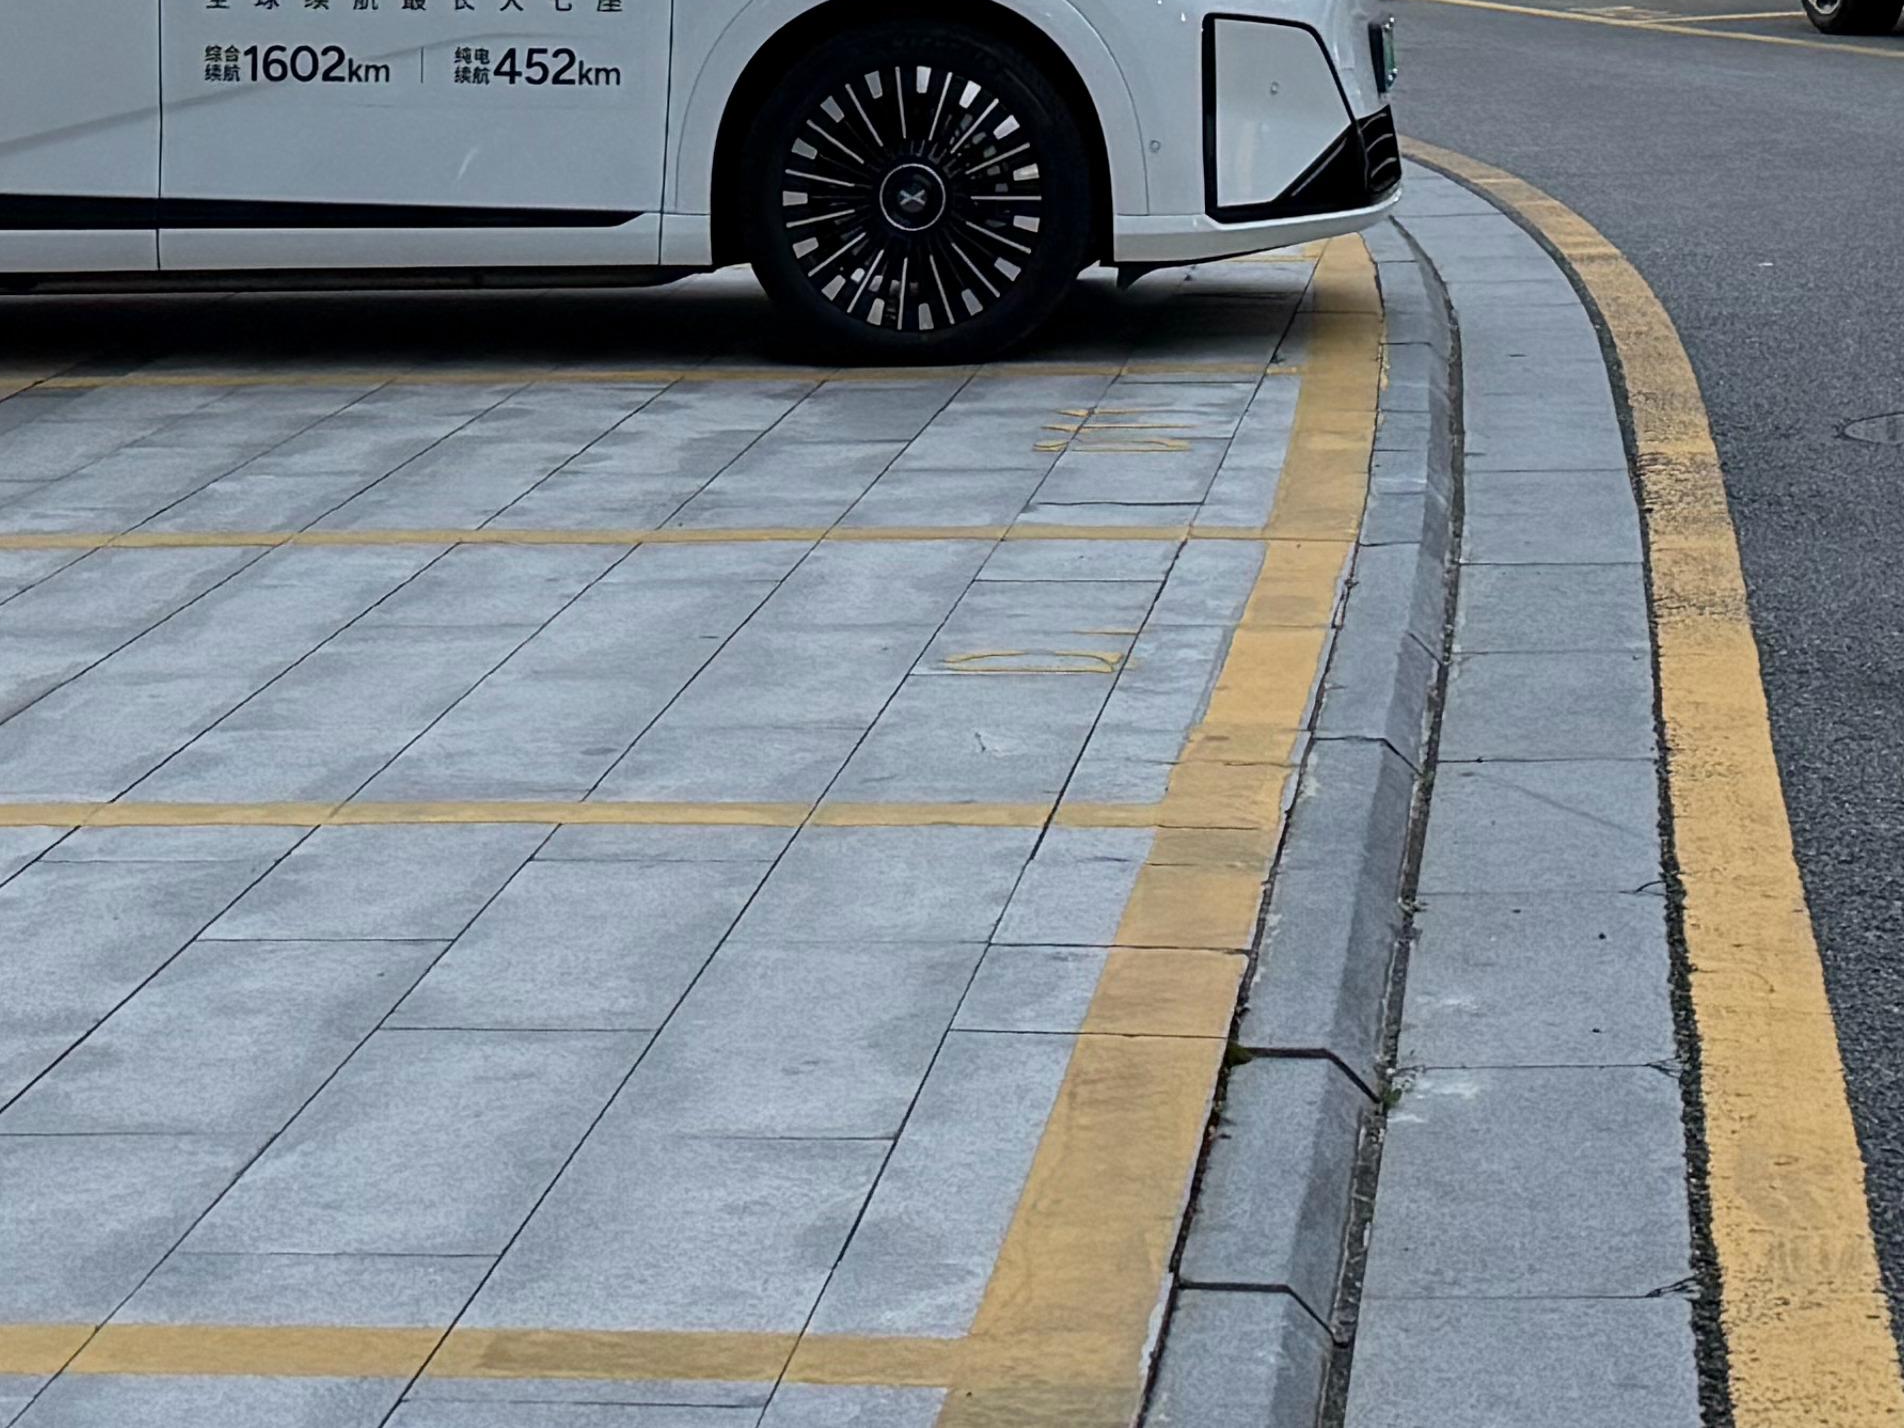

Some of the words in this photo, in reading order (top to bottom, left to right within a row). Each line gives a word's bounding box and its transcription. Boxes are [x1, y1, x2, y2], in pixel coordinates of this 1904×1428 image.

[204, 45, 240, 63] 综合
[454, 46, 491, 65] 纯电
[204, 63, 241, 82] 续航
[243, 45, 390, 83] 1602km
[493, 47, 621, 86] 452km
[454, 65, 490, 85] 续航
